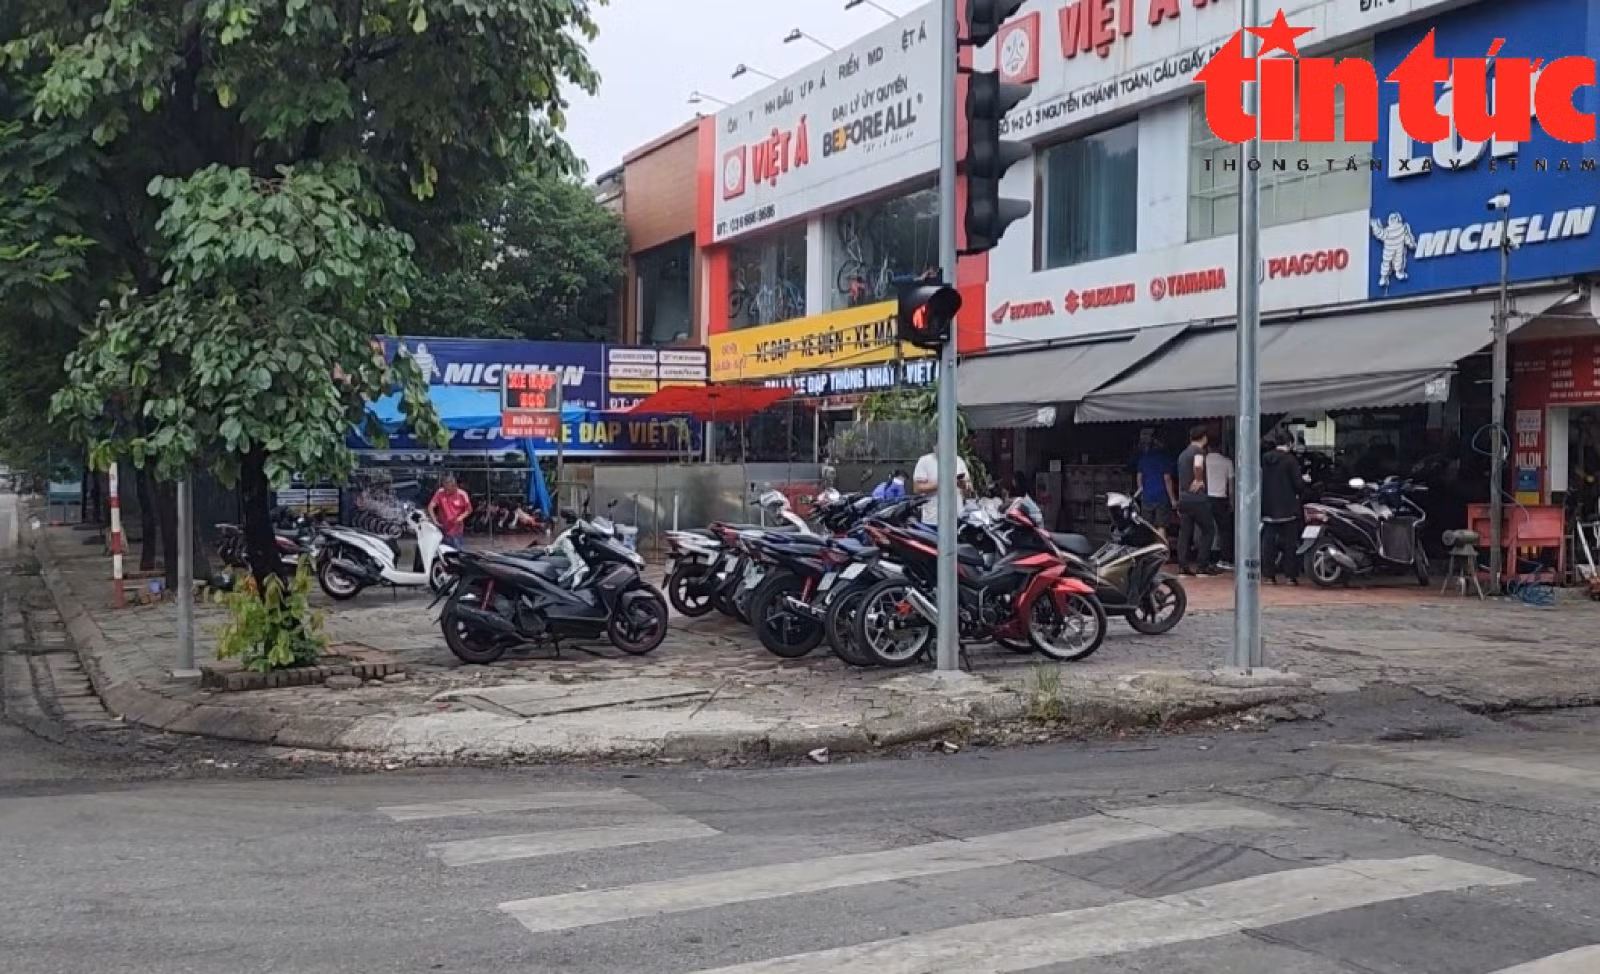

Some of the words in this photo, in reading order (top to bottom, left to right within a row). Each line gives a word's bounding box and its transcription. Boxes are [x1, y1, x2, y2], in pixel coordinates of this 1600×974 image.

[751, 127, 792, 188] VIỆT
[794, 113, 809, 168] Á
[1413, 205, 1597, 260] MICHELIN
[1268, 248, 1350, 279] PIAGGIO
[1081, 283, 1136, 310] SUZUKI
[1167, 267, 1227, 297] YAMAHA
[1010, 300, 1054, 321] HONDA
[578, 421, 622, 449] ĐẠP
[628, 417, 670, 448] VIỆT
